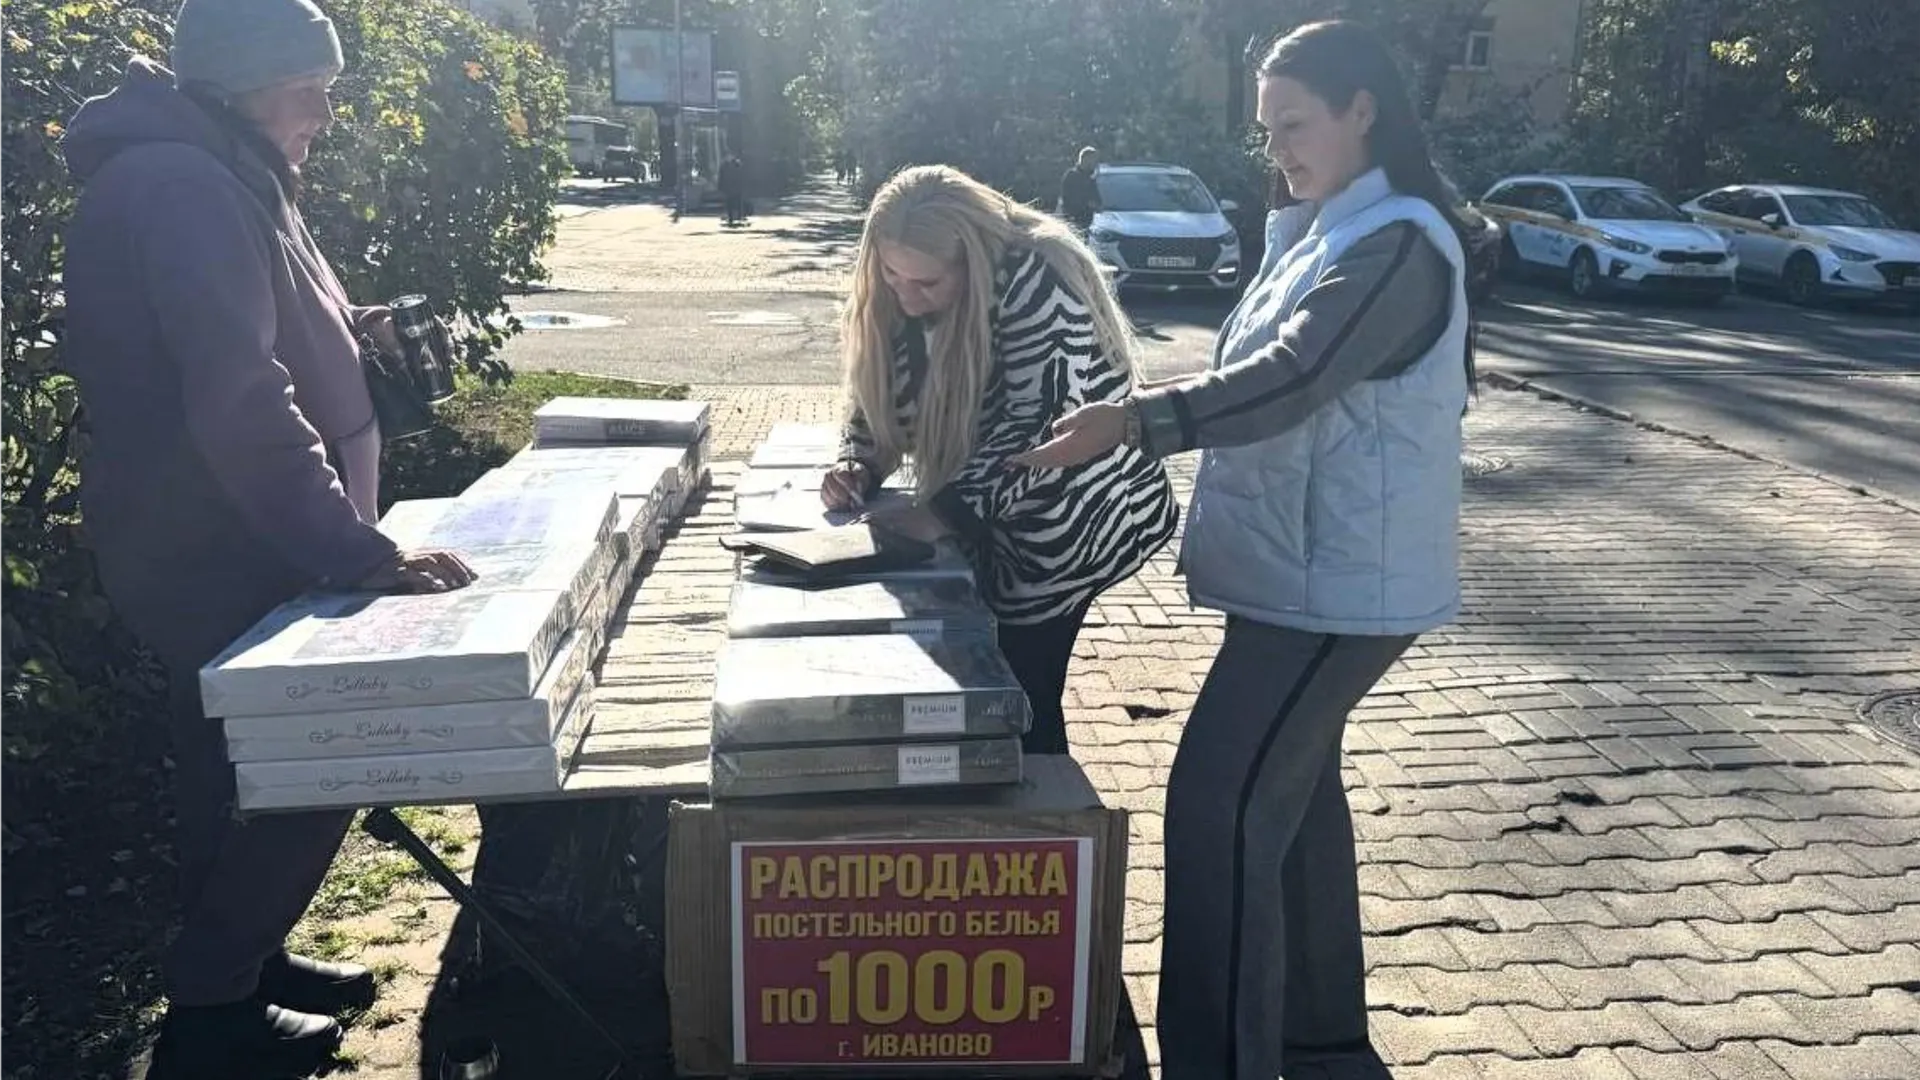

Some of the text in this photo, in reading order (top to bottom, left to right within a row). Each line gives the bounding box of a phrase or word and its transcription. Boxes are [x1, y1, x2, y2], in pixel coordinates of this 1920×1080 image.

[329, 673, 389, 694] Lullaby
[910, 702, 958, 714] PREMIUM
[355, 719, 411, 740] Lullaby
[905, 755, 952, 766] PREMIUM
[365, 767, 421, 788] Lullaby
[750, 852, 1069, 902] РАСПРОДАЖА
[754, 909, 1061, 939] ПОСТЕЛЬНОГО БЕЛЬЯ
[817, 949, 1025, 1025] 1000
[862, 1032, 993, 1058] ИВАНОВО
